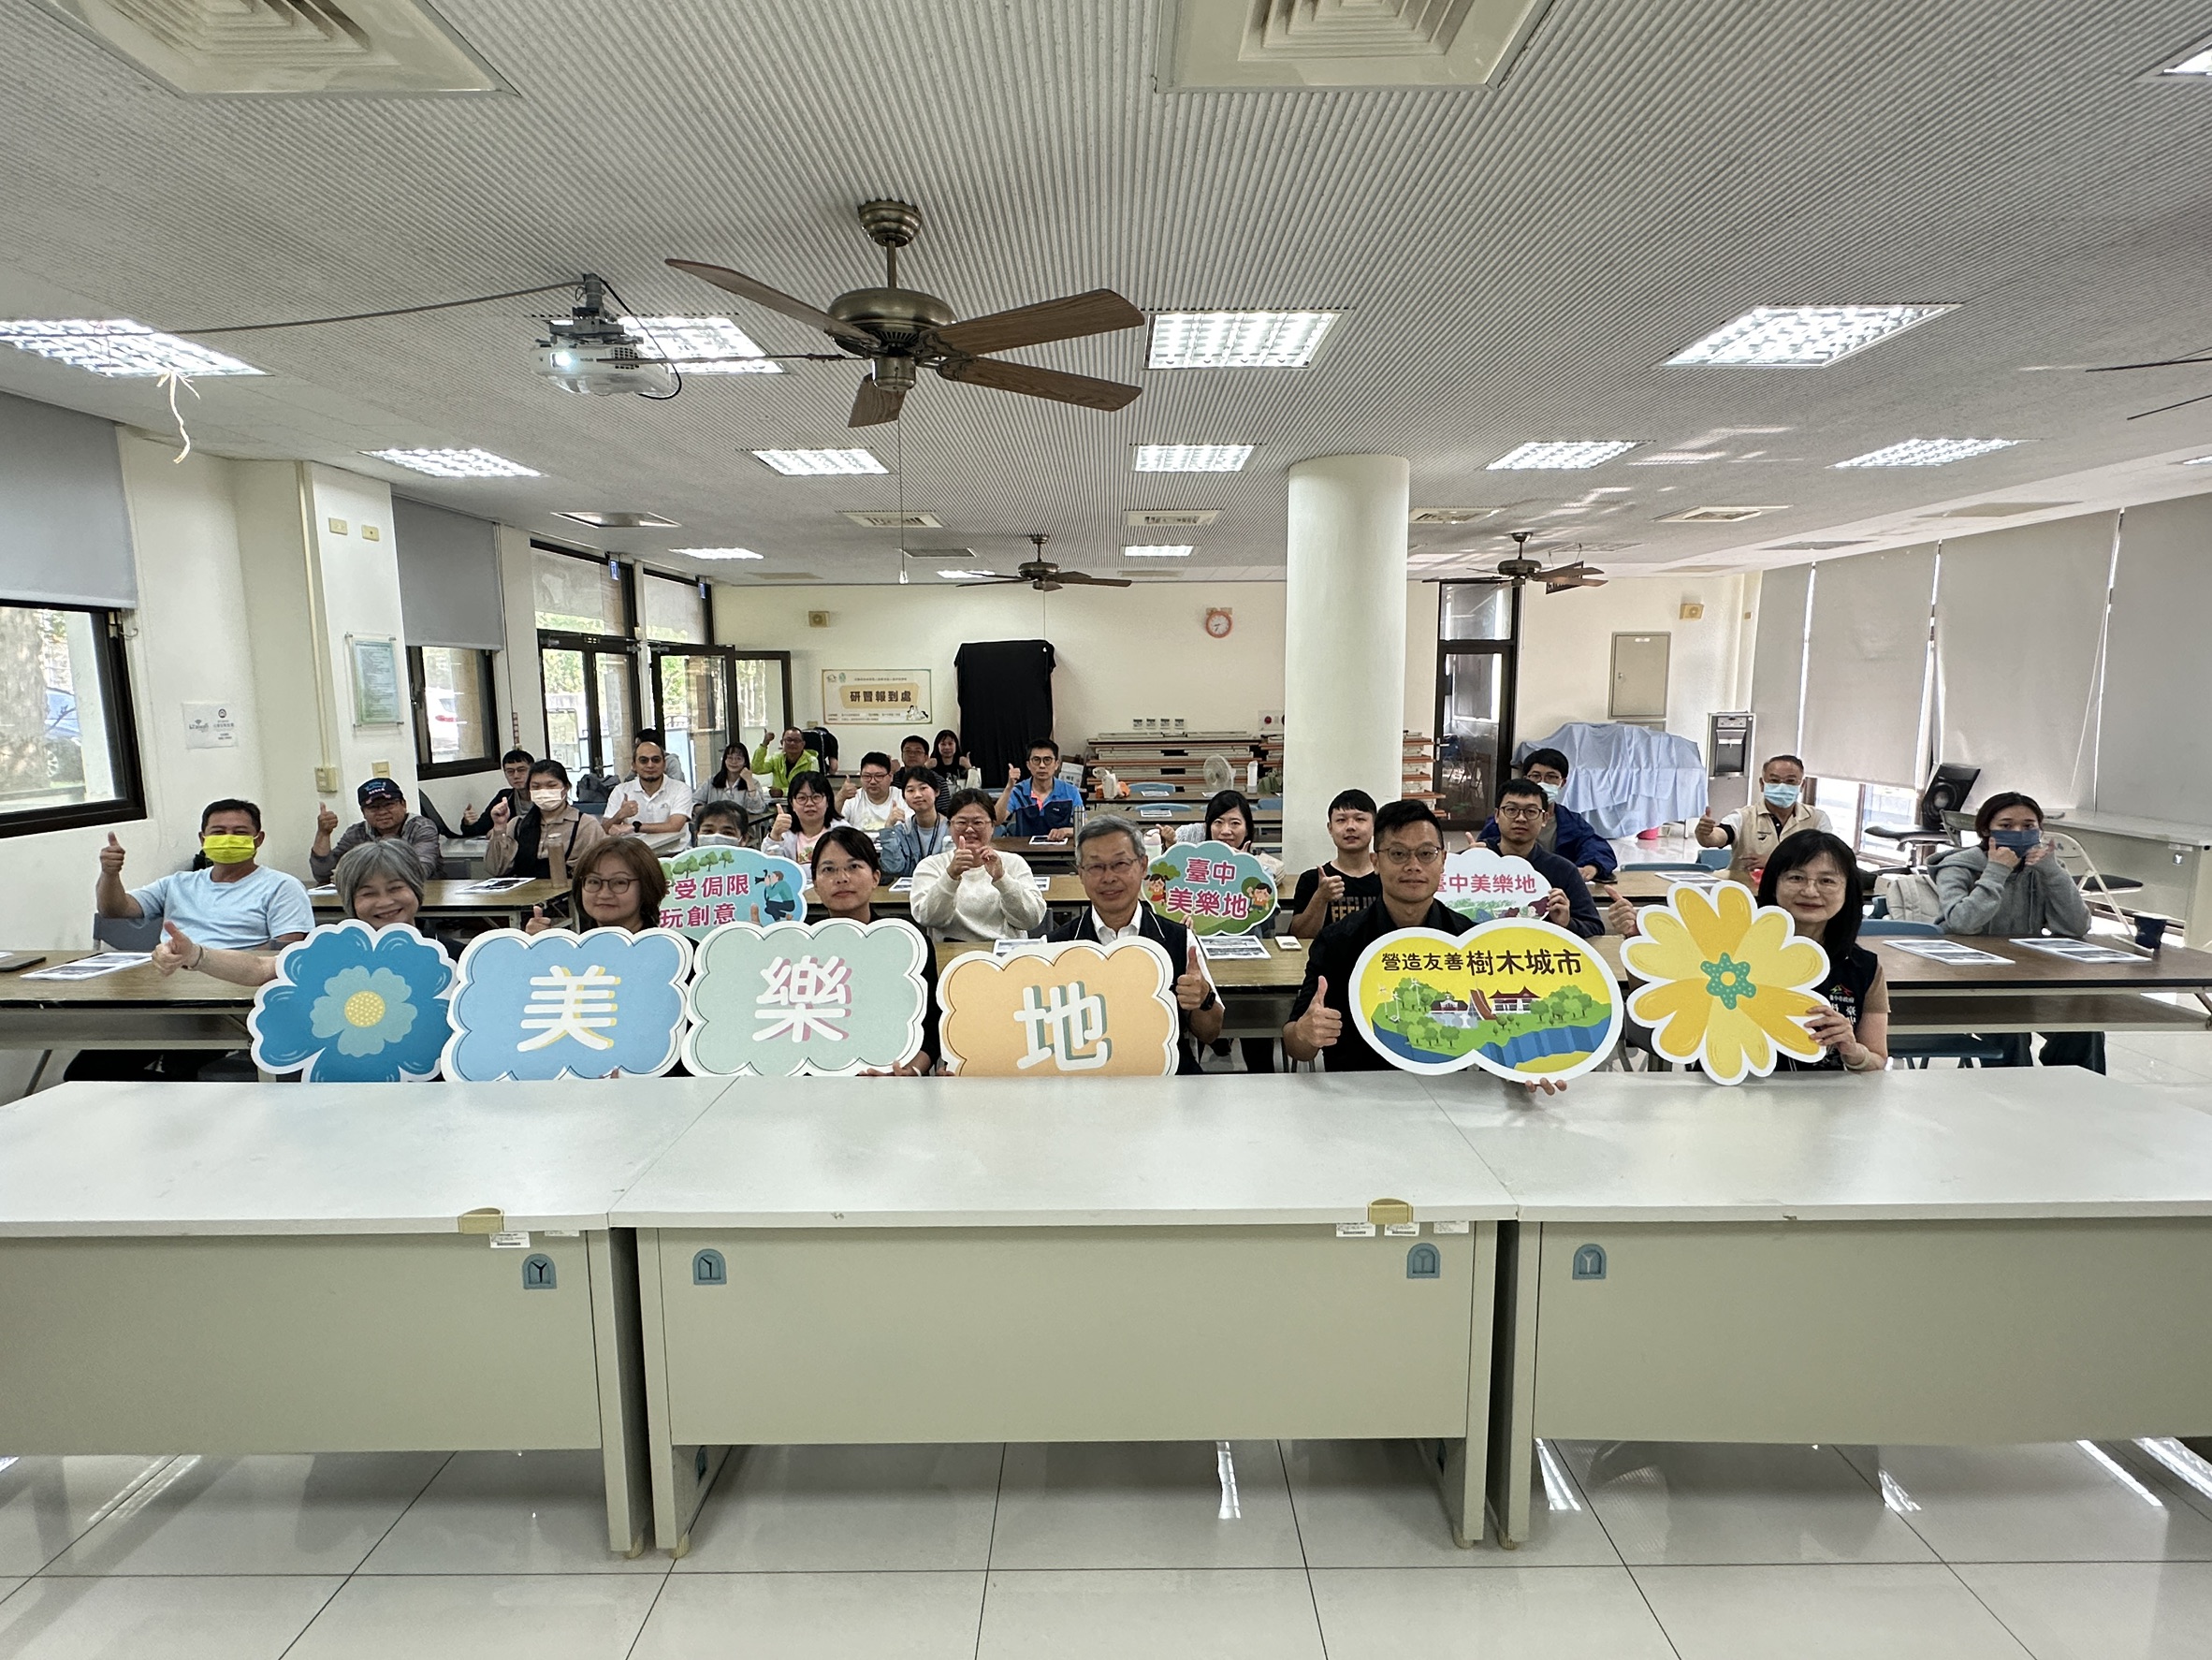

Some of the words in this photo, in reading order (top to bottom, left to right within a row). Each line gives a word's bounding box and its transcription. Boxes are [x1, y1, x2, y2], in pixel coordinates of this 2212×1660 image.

[850, 691, 911, 702] 研習報到處
[1186, 858, 1236, 884] 臺中
[664, 874, 749, 899] 受侷限
[660, 903, 735, 928] 玩創意
[1167, 887, 1247, 919] 美樂地
[517, 965, 620, 1052] 美
[752, 955, 851, 1043] 樂
[1013, 981, 1112, 1070] 地
